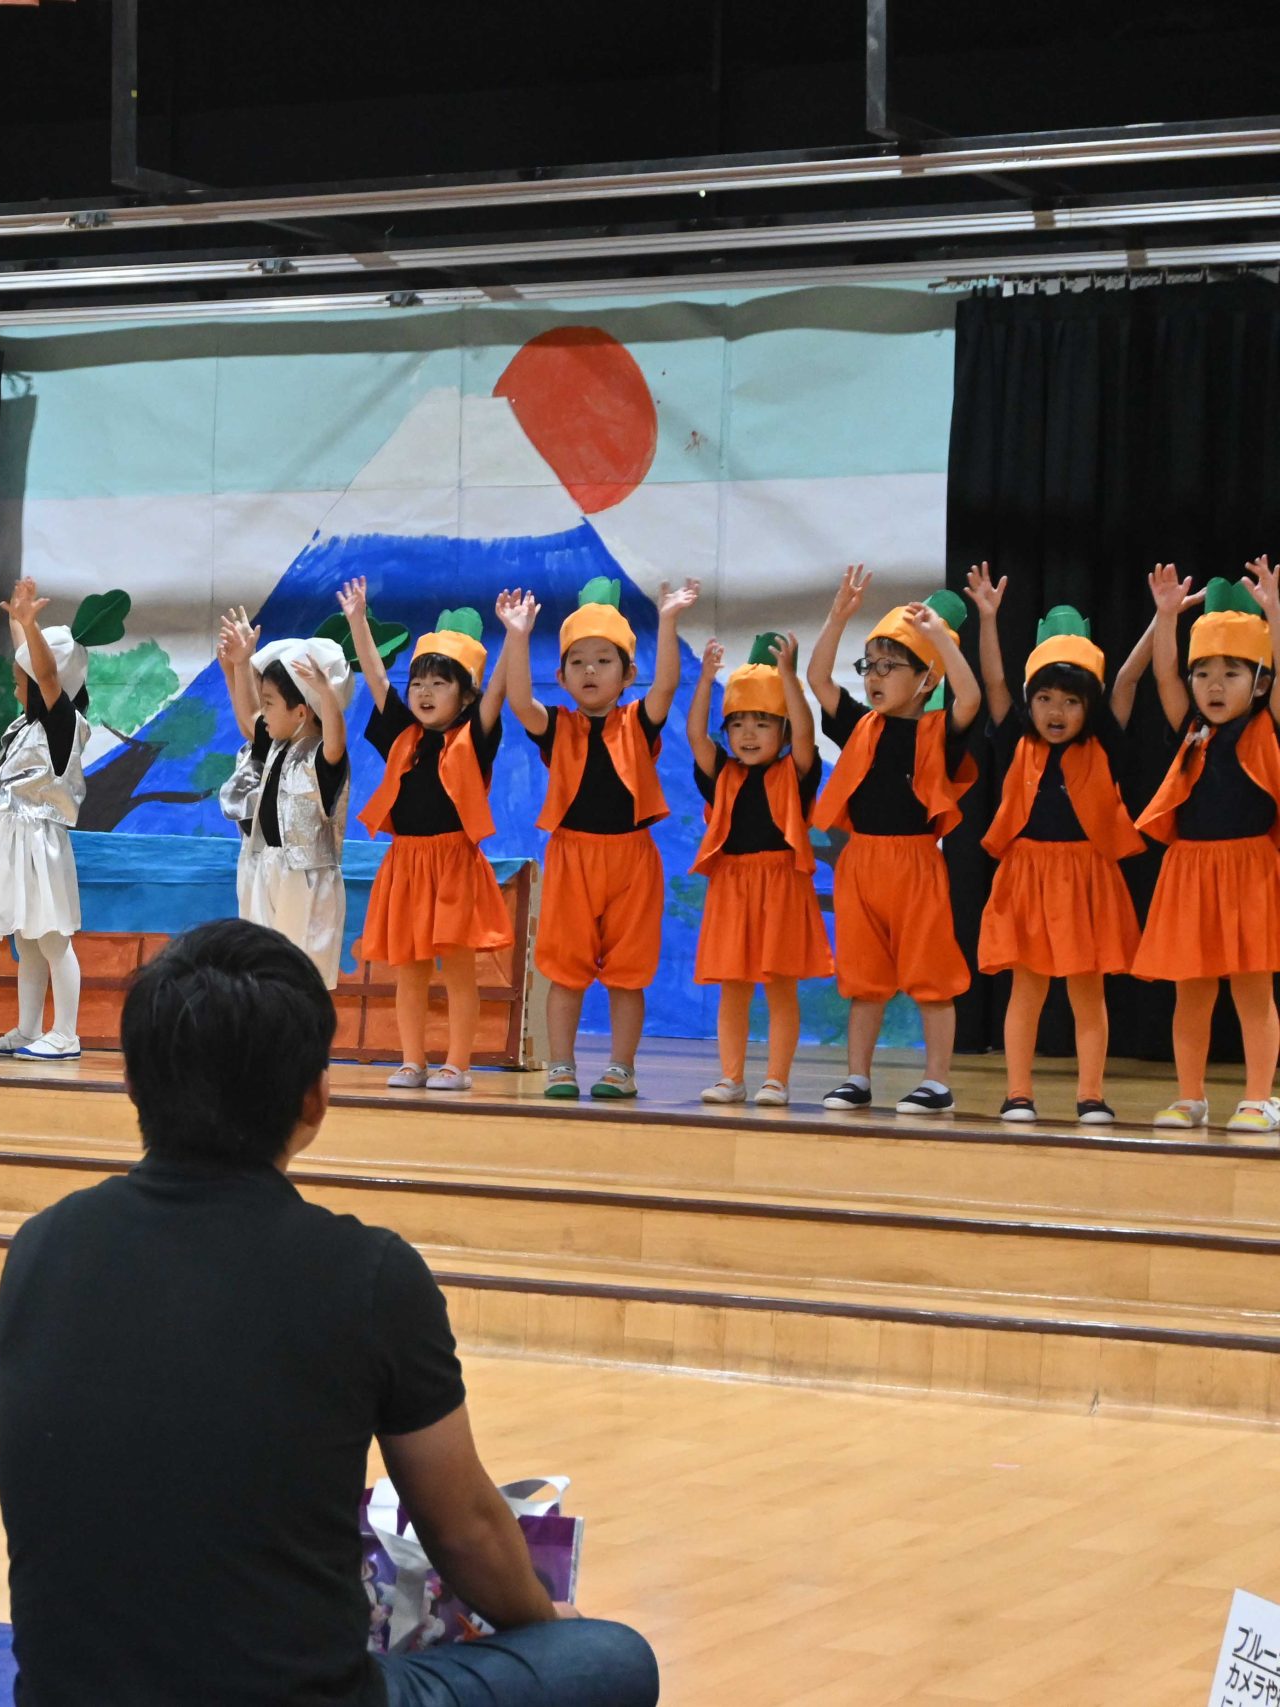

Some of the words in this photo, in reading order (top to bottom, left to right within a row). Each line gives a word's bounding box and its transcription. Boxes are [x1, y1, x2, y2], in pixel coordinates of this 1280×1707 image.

[1233, 1626, 1280, 1672] ブルー
[1225, 1662, 1280, 1707] カメラや
